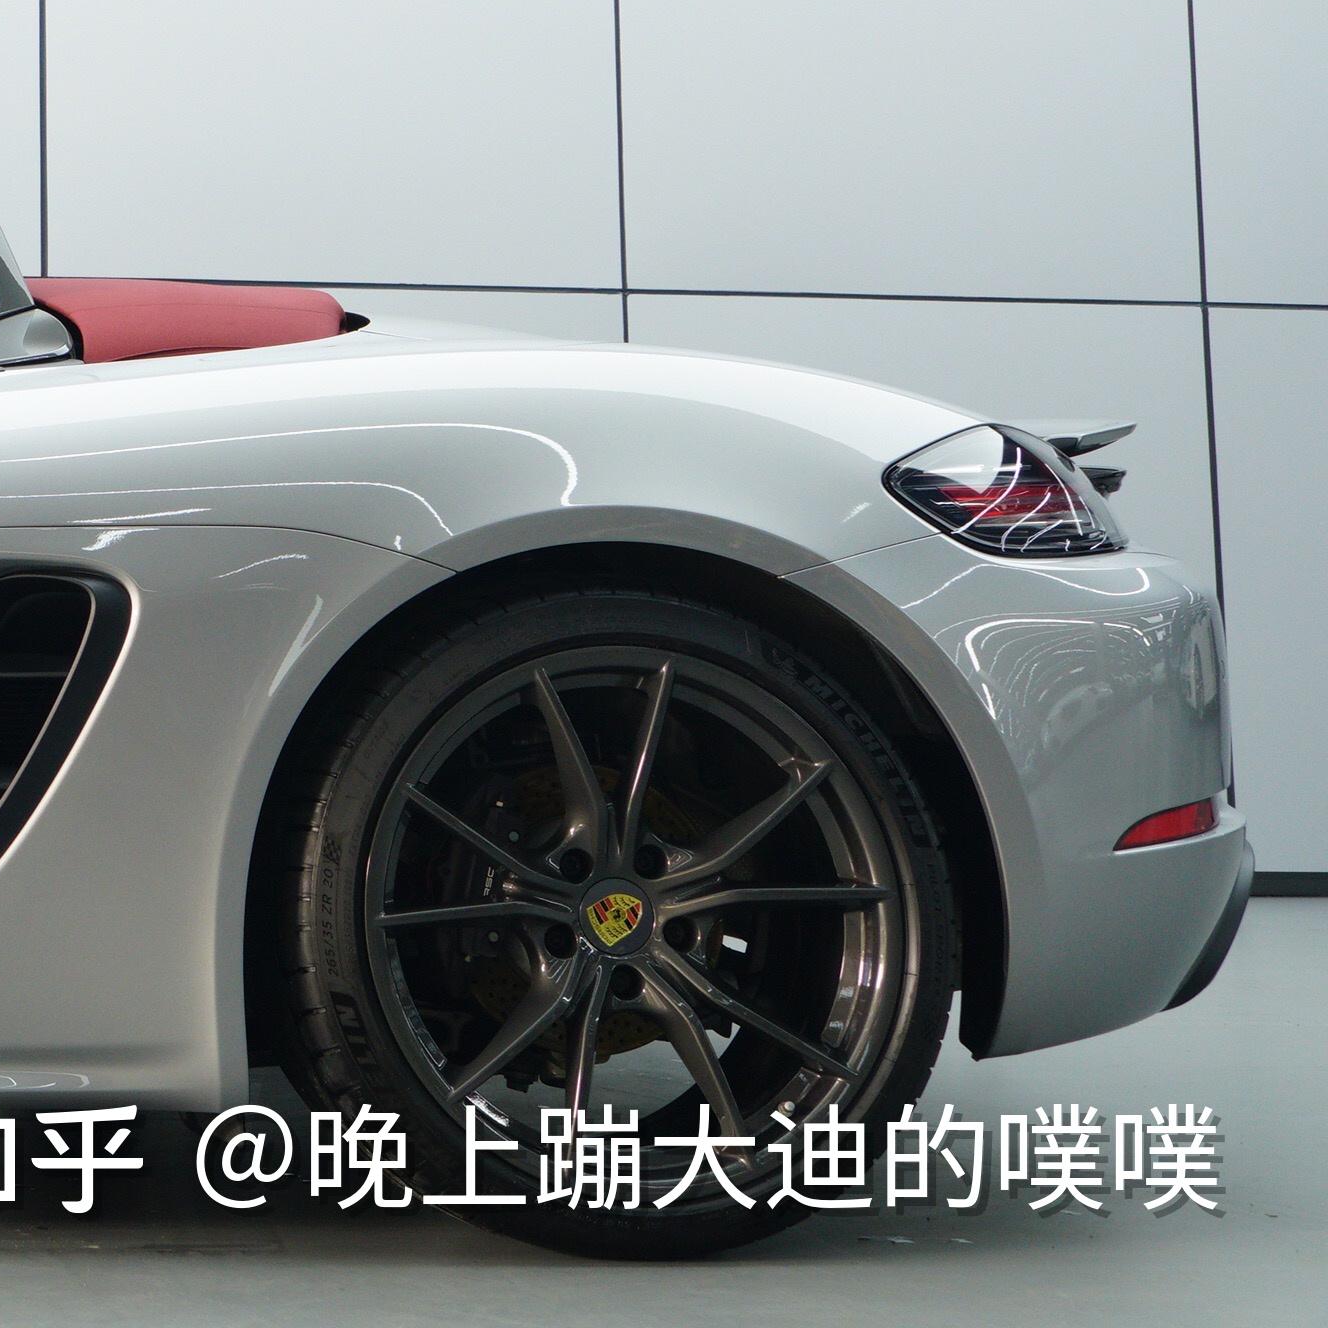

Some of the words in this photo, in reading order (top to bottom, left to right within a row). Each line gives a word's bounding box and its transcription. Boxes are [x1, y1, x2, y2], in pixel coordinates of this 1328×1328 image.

[321, 869, 335, 888] 20
[321, 896, 336, 914] ZR
[321, 921, 339, 977] 265/35
